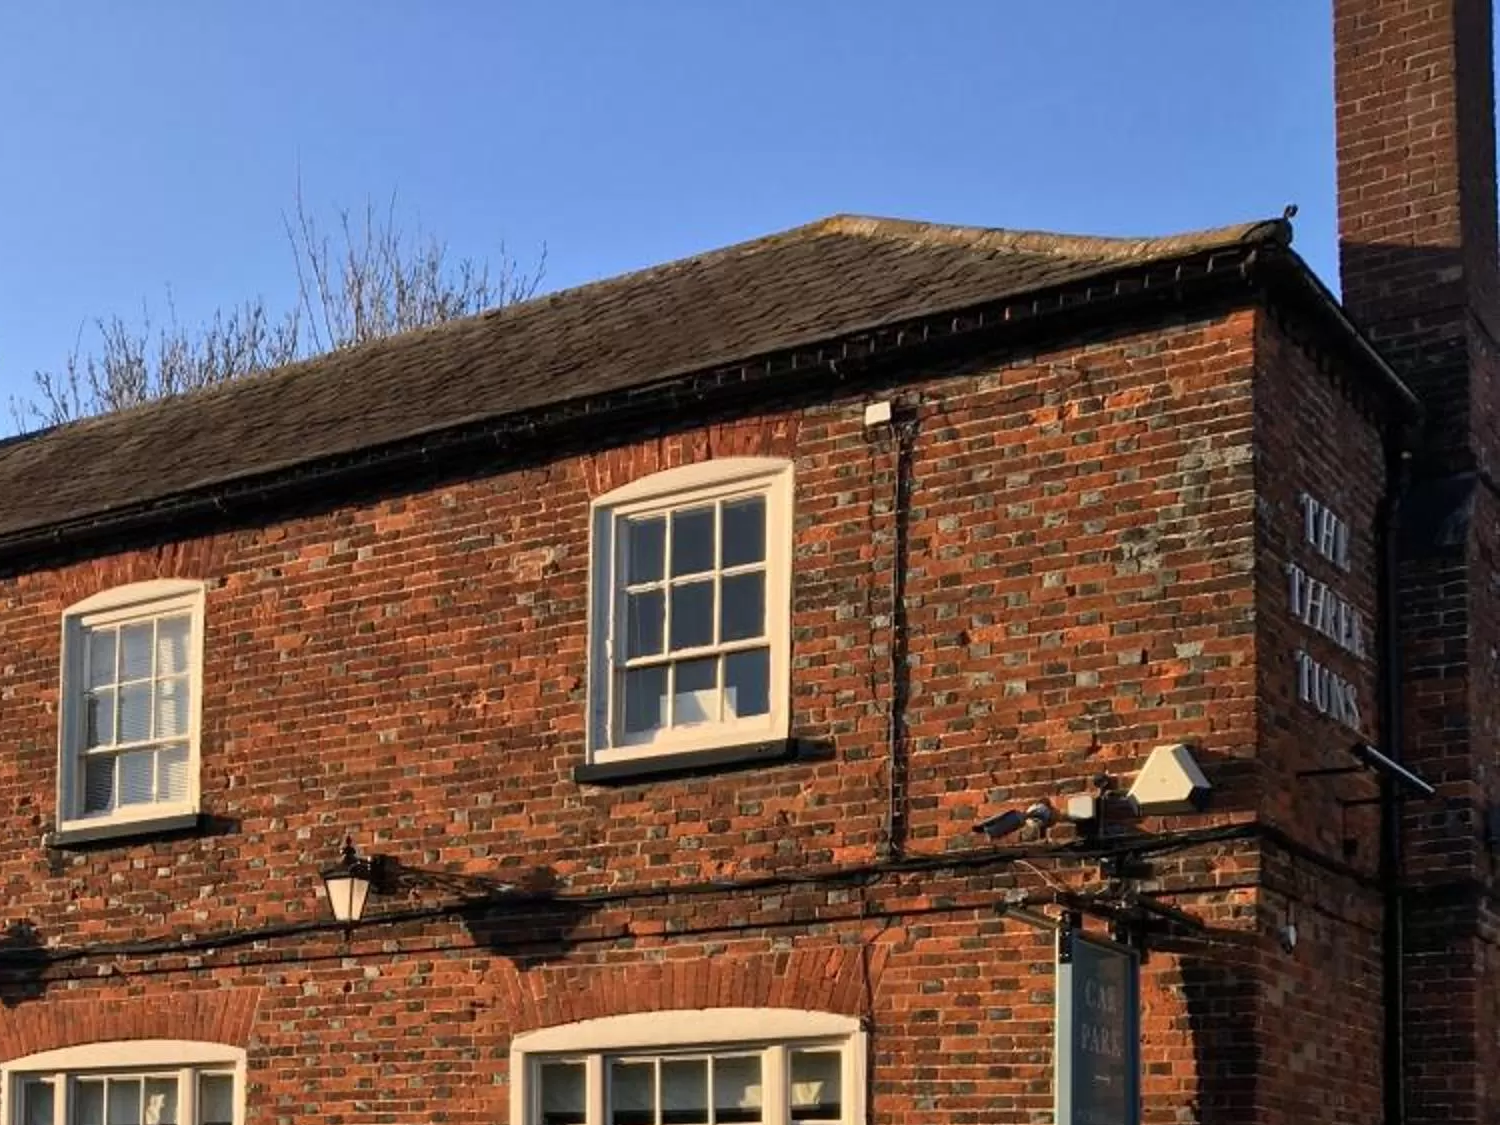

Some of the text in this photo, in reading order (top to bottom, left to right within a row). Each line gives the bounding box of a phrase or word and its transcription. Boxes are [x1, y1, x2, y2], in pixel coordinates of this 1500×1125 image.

[1299, 491, 1352, 574] THE
[1284, 561, 1367, 660] THREE
[1296, 649, 1361, 731] TUNS
[1080, 1021, 1121, 1056] PARK
